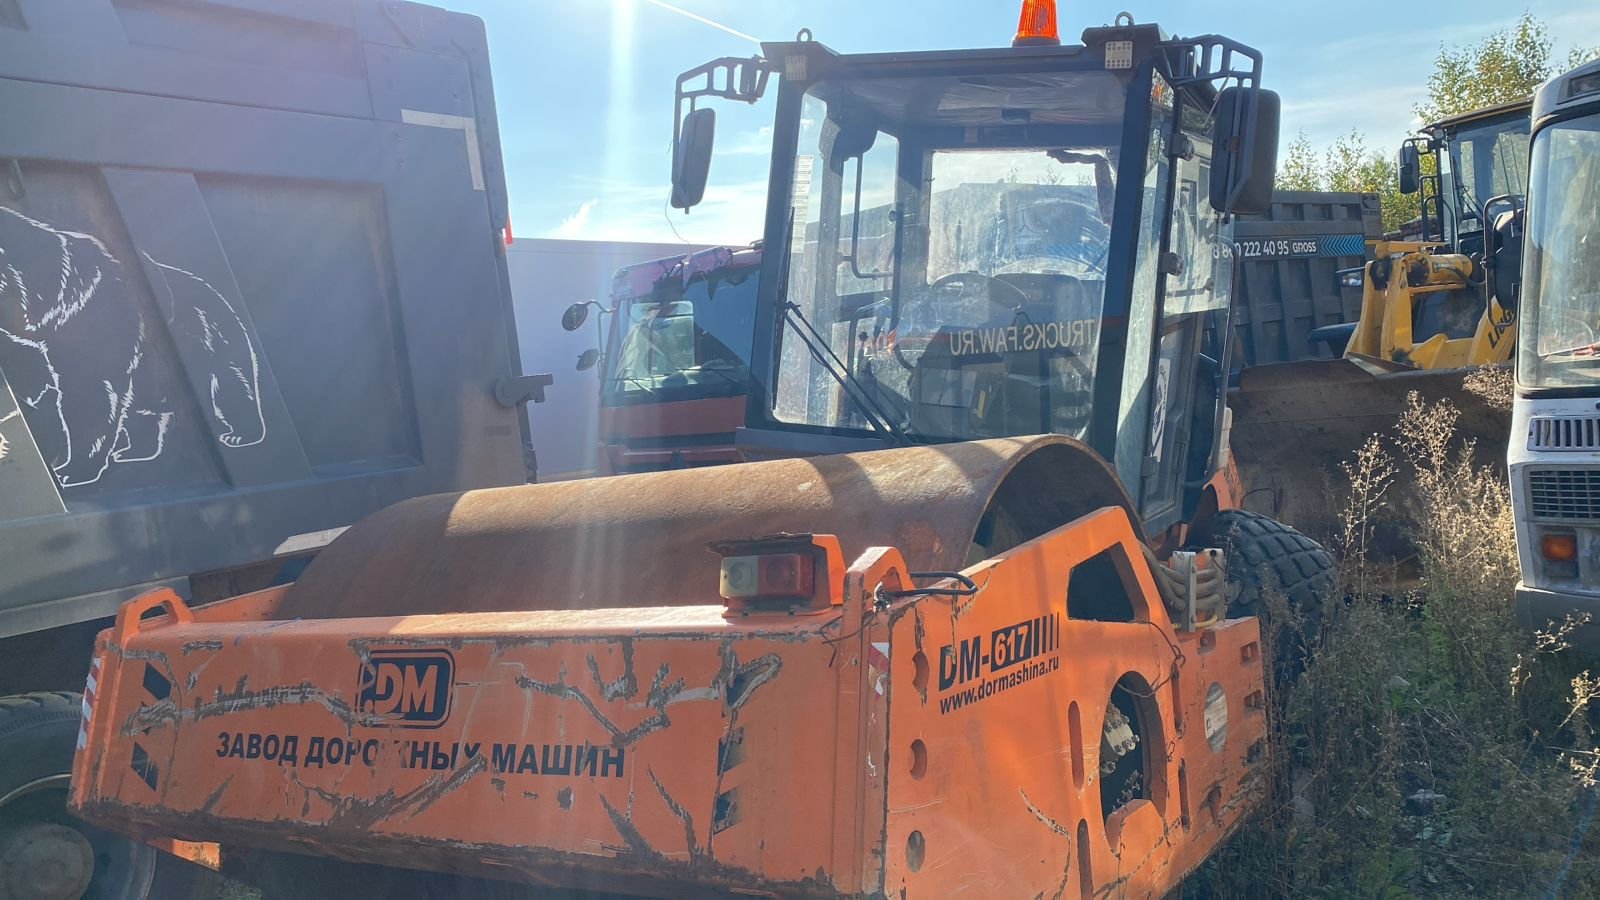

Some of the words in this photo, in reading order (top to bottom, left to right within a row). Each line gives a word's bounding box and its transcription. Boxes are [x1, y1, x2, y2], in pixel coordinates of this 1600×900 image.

[1244, 242, 1262, 257] 222
[1263, 241, 1276, 256] 40
[1277, 240, 1289, 255] 95
[939, 622, 1031, 692] DM-617
[366, 662, 439, 714] DM
[940, 656, 1059, 715] www.dormashina.ru
[216, 731, 299, 767] ЗАВОД
[491, 743, 625, 778] МАШИН
